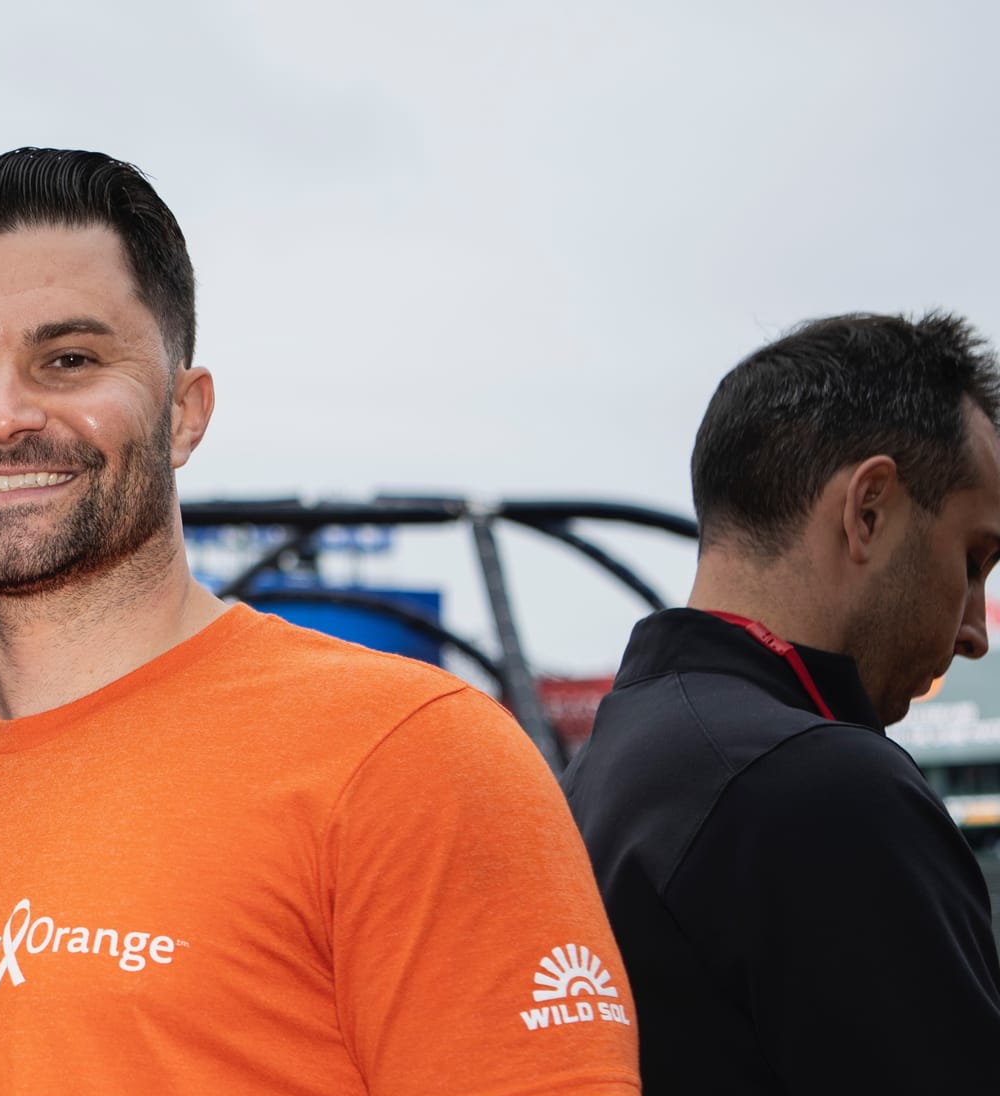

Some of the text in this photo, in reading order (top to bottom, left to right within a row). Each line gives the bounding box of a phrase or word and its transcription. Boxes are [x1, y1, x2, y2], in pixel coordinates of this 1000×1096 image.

[26, 916, 174, 972] Orange
[520, 1002, 631, 1031] WILD SOL
